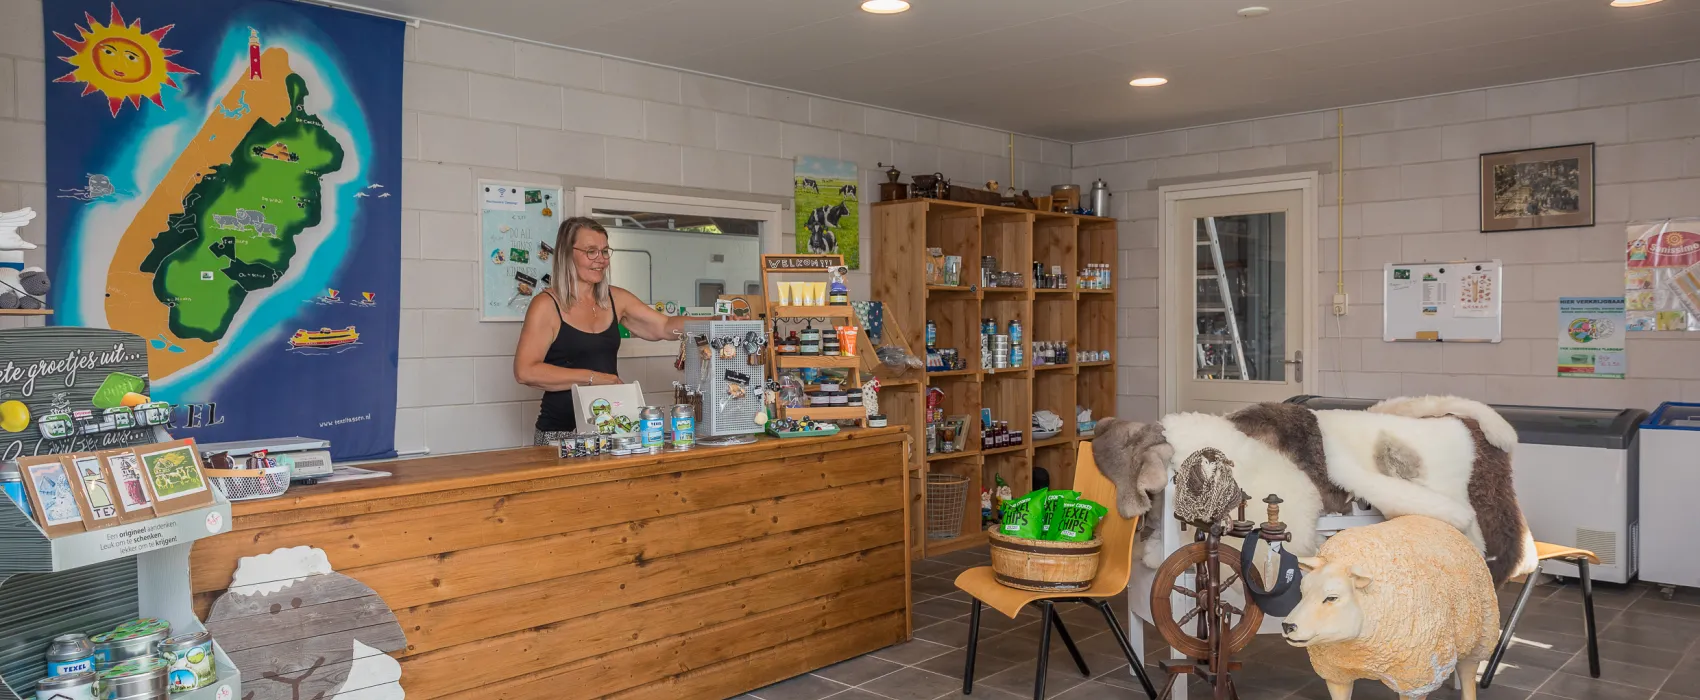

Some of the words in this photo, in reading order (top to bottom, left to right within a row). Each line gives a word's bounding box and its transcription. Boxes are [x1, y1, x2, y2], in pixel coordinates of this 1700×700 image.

[22, 349, 98, 397] groetjes
[1063, 507, 1089, 522] TEXEL
[106, 533, 118, 541] Een
[119, 527, 147, 538] origineel
[147, 521, 176, 532] aandenken
[1057, 518, 1085, 534] CHIPS
[100, 541, 114, 551] Leuk
[115, 539, 126, 547] om
[126, 538, 133, 546] te
[138, 543, 148, 551] om
[148, 541, 155, 549] te
[155, 536, 178, 547] krijgen!
[63, 664, 87, 673] TEXEL
